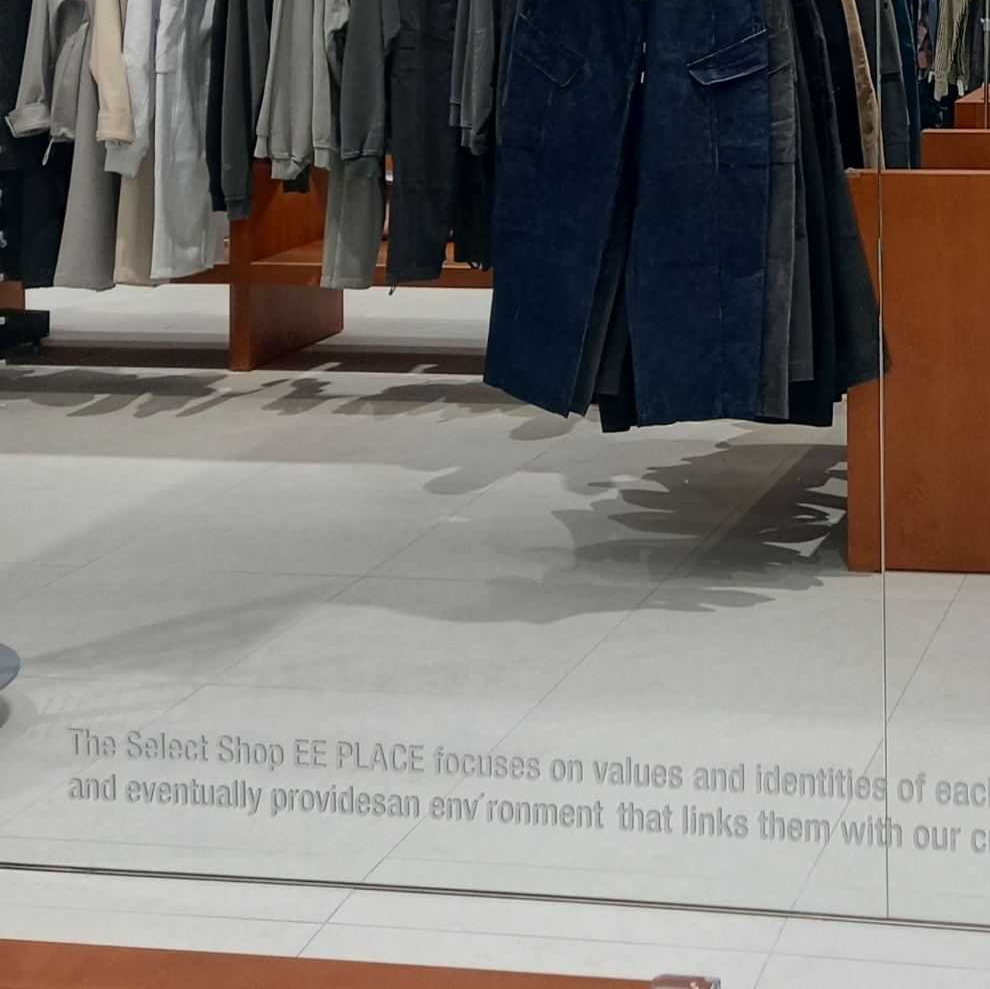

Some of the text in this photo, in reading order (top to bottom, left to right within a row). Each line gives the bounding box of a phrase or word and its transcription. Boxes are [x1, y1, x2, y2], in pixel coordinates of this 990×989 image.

[68, 728, 116, 758] The
[125, 730, 209, 762] Select
[217, 735, 285, 771] Shop
[293, 739, 327, 768] EE
[336, 741, 425, 774] PLACE
[432, 746, 541, 781] focuses
[549, 758, 584, 784] on
[593, 757, 683, 789] values
[693, 763, 745, 793] and
[755, 763, 887, 801] identities
[897, 773, 926, 803] of
[67, 774, 116, 803] and
[125, 777, 263, 816] eventually
[617, 801, 673, 835] that
[682, 803, 749, 839] links
[758, 810, 832, 843] them
[841, 816, 903, 848] with
[913, 824, 961, 851] our
